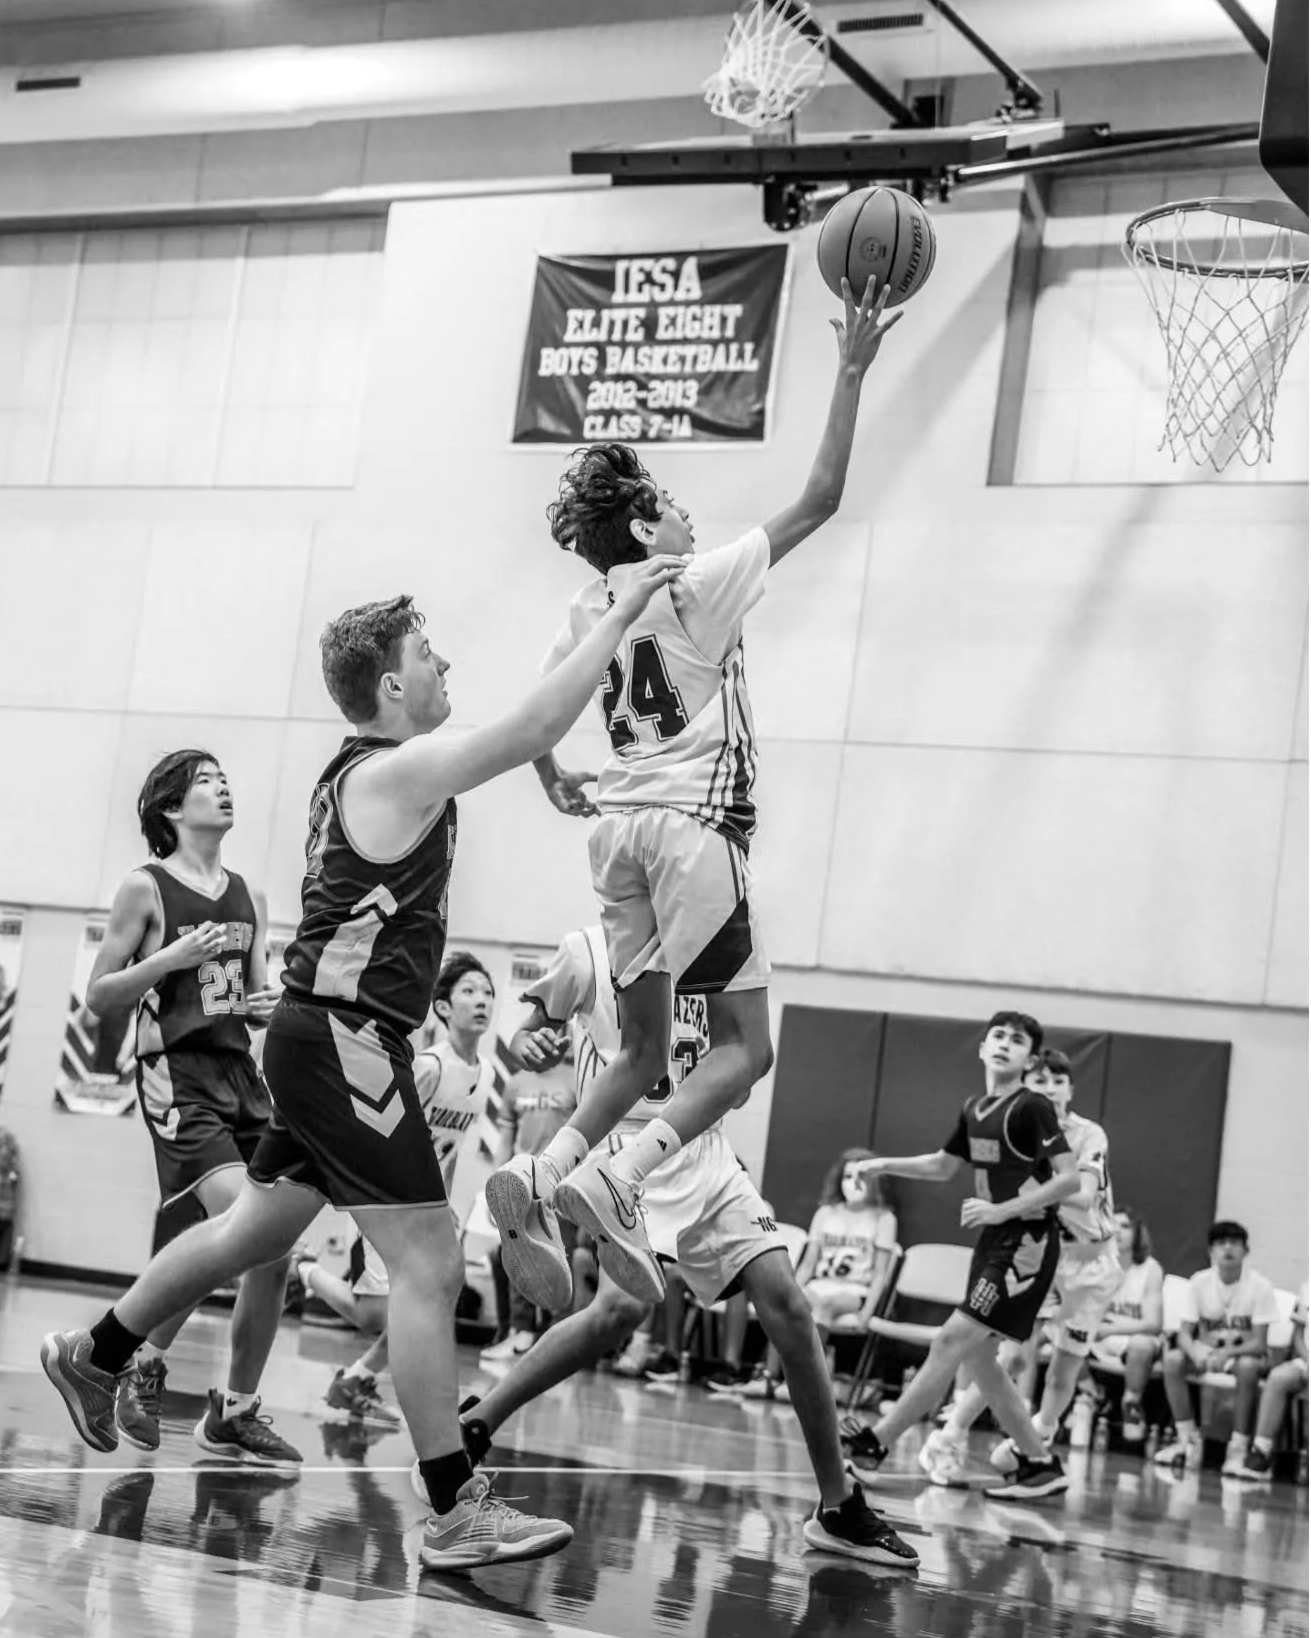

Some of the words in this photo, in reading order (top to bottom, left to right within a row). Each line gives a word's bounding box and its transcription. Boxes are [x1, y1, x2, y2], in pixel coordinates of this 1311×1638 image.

[898, 216, 923, 293] EVOLUTION
[611, 256, 702, 303] IESA
[563, 307, 647, 342] ELITE
[655, 304, 743, 340] EIGHT
[538, 346, 599, 376] BOYS
[604, 342, 759, 374] BASKETBALL
[586, 379, 699, 410] 2012-2013
[583, 415, 643, 439] CLASS
[648, 414, 693, 438] 7-1A
[600, 633, 690, 752] 24
